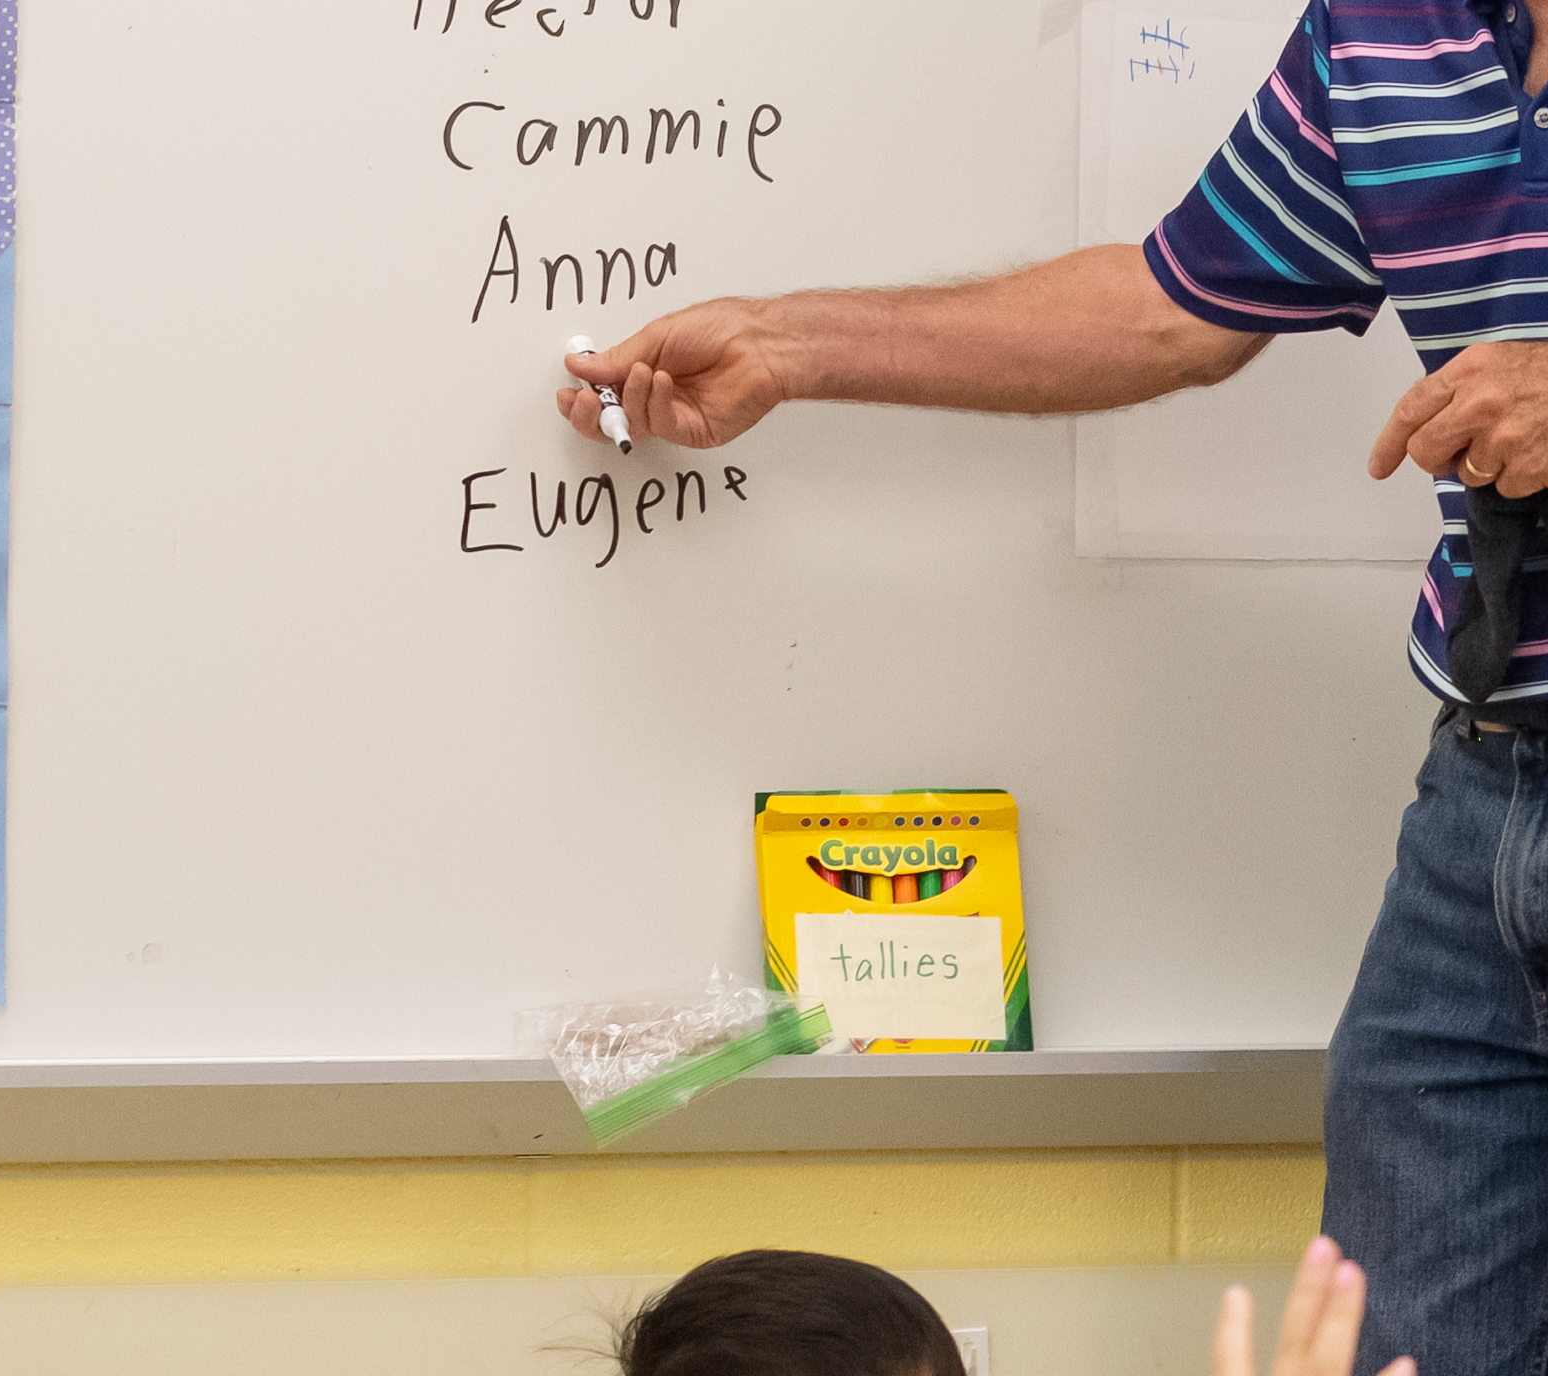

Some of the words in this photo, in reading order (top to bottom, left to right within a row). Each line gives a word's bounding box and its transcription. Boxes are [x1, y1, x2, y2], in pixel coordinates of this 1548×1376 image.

[442, 97, 783, 184] Cammie
[470, 214, 678, 325] Anna
[459, 464, 749, 570] Eugene
[820, 839, 960, 873] Crayola
[830, 939, 960, 984] tallies
